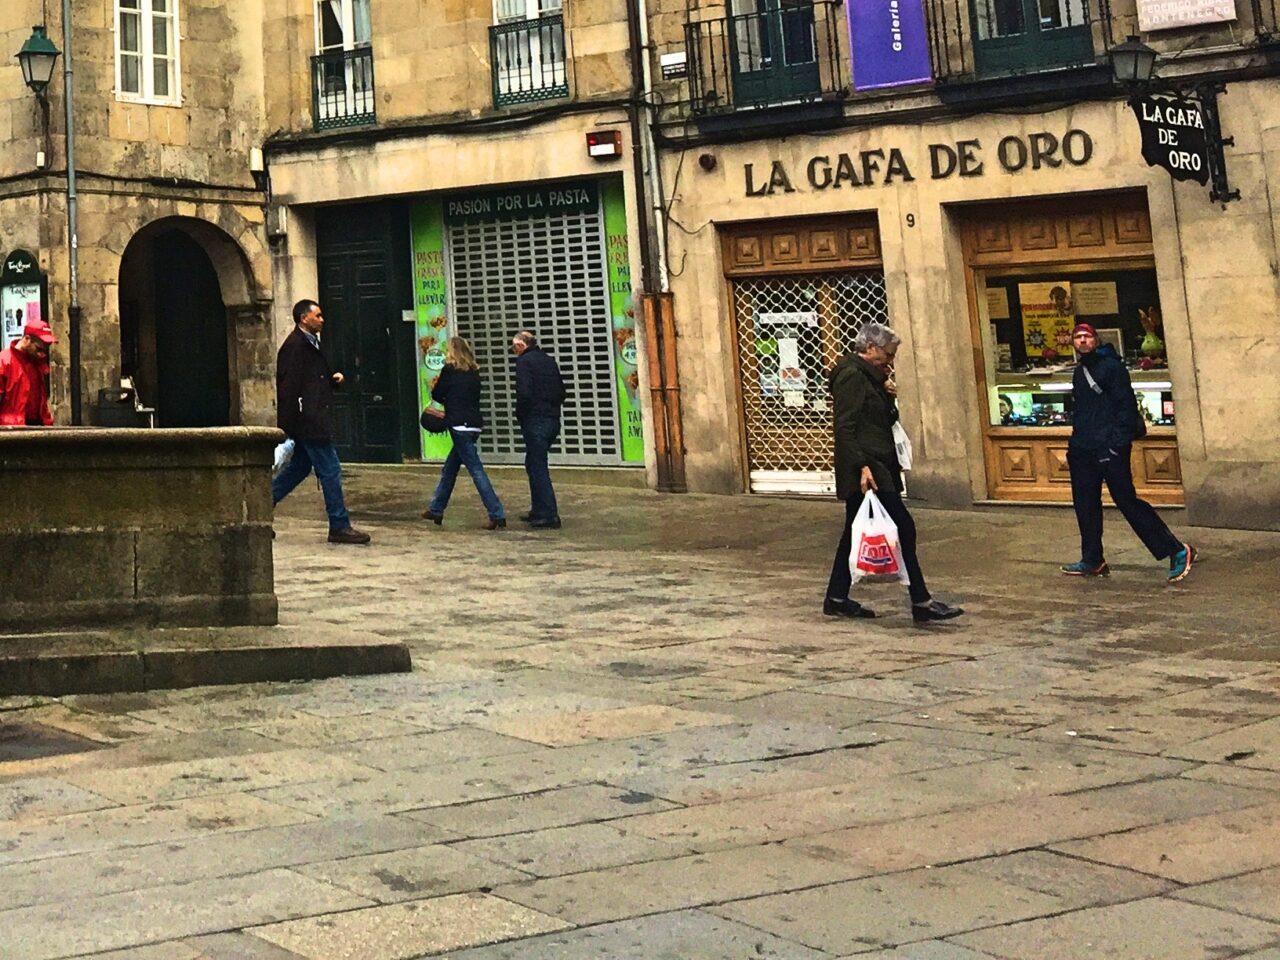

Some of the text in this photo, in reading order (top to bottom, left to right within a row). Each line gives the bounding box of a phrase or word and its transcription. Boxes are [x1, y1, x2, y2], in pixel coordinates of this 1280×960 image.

[1142, 0, 1191, 13] FEDERICO
[889, 0, 902, 52] Galería
[1142, 102, 1205, 129] LA GAFA
[1158, 128, 1179, 146] DE
[744, 128, 1095, 198] LA GAFA DE ORO
[1168, 150, 1202, 171] ORO
[497, 194, 523, 211] POR
[527, 192, 544, 208] LA
[549, 189, 590, 207] PASTA
[906, 212, 916, 228] 9
